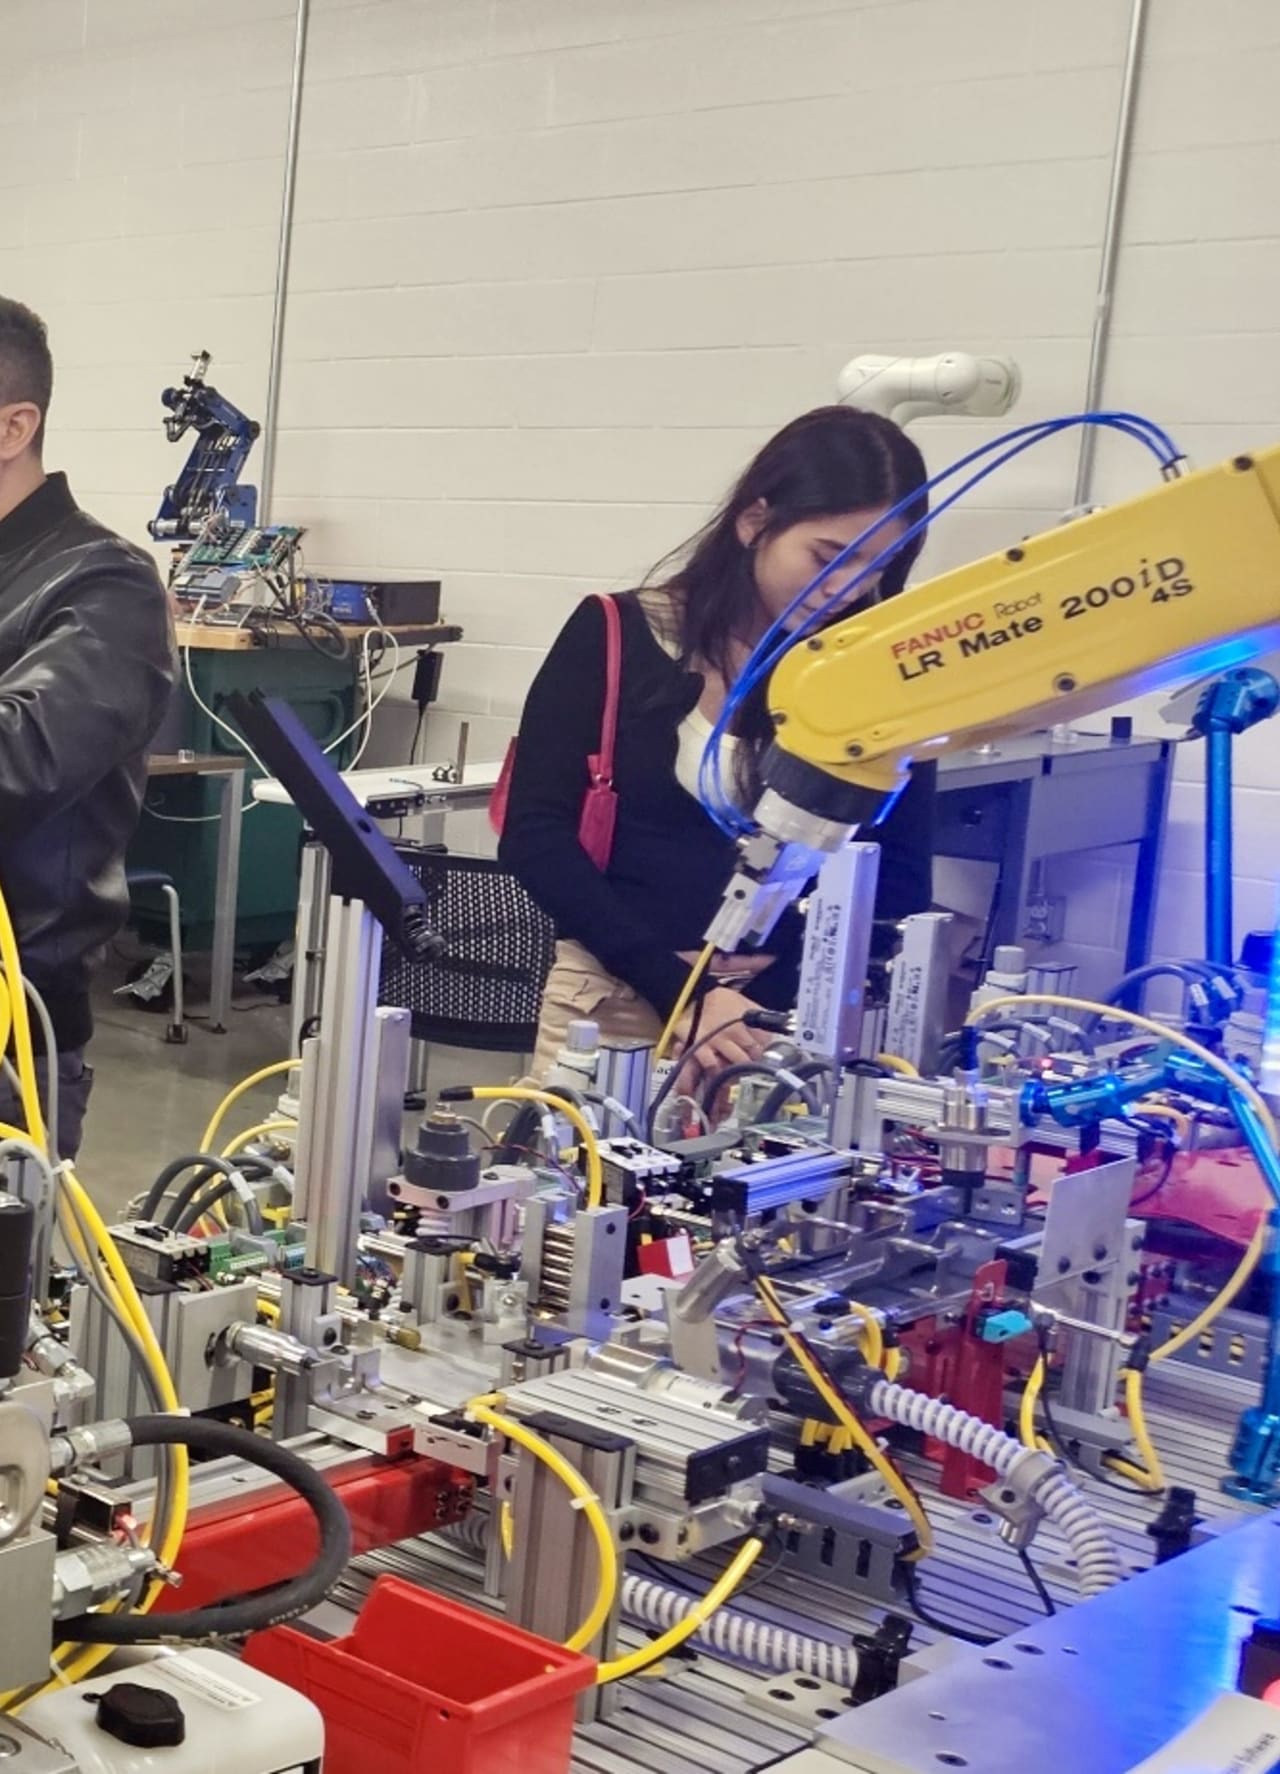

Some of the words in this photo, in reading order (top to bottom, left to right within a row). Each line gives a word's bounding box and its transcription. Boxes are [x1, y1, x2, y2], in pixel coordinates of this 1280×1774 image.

[1151, 577, 1195, 606] 4S
[890, 611, 986, 660] FANUC
[993, 592, 1044, 622] Robot
[896, 650, 946, 681] LR
[959, 614, 1044, 658] Mate
